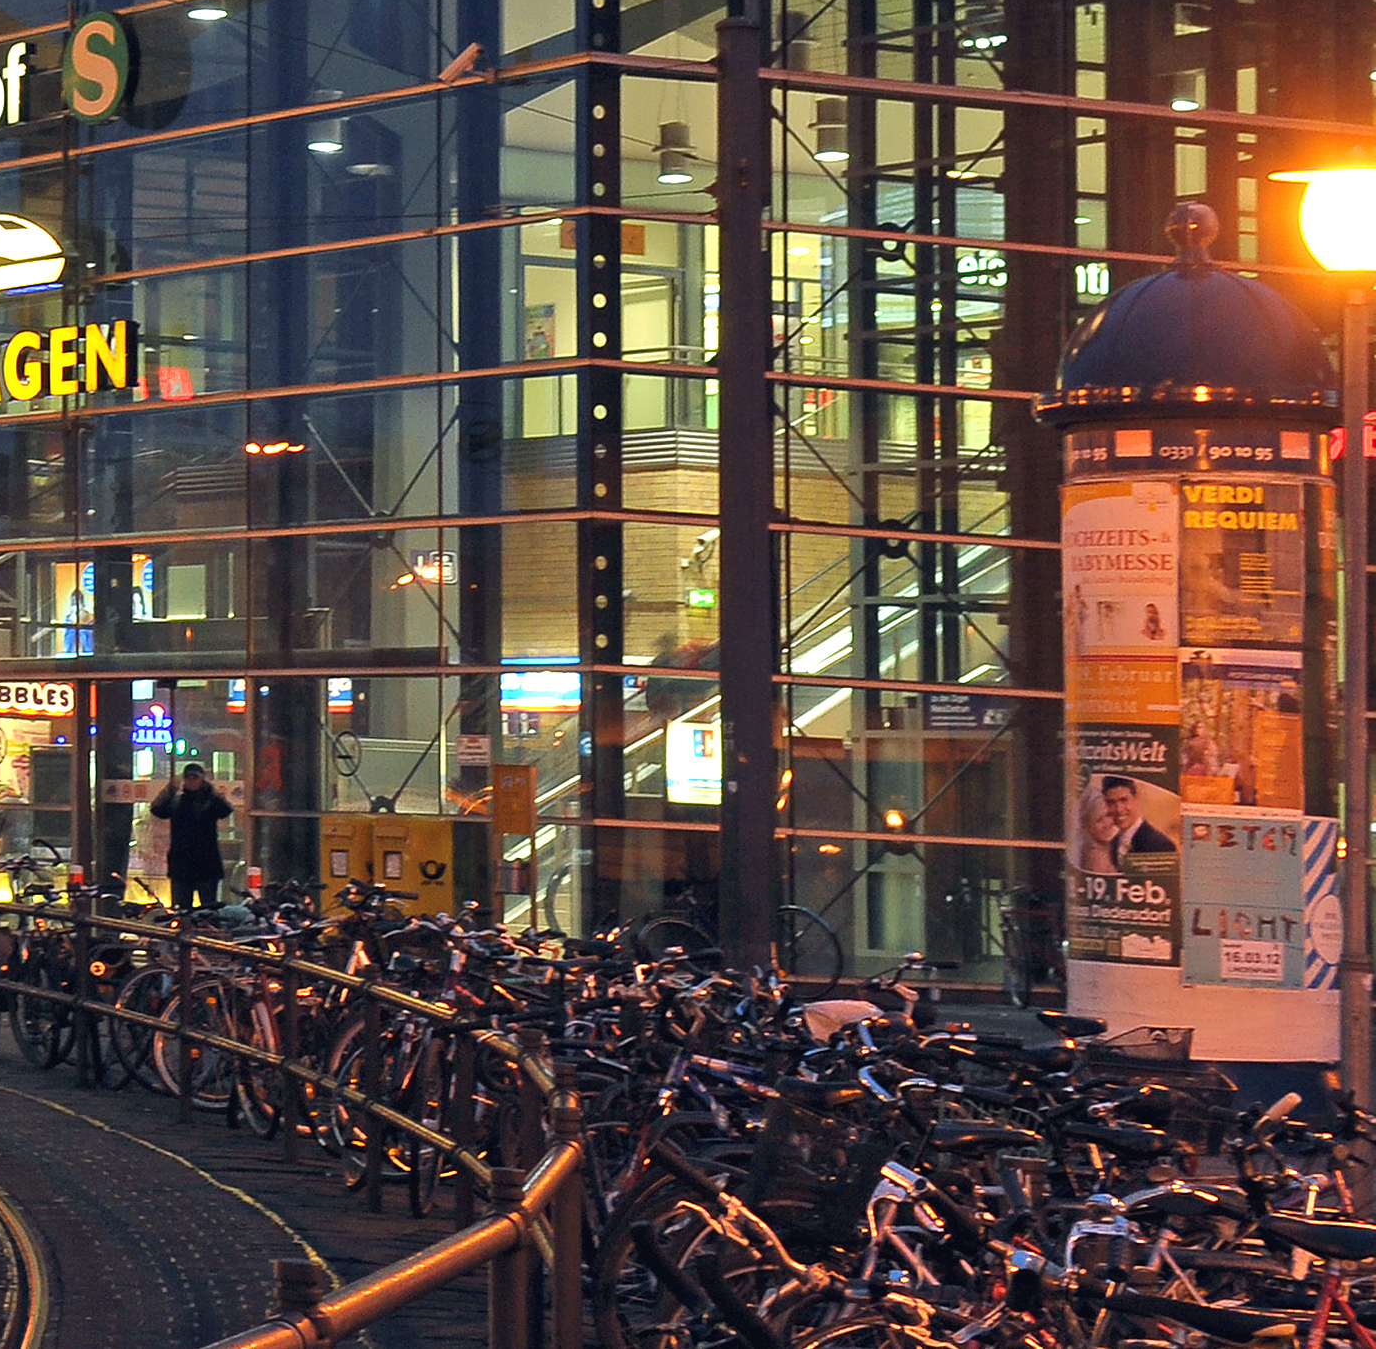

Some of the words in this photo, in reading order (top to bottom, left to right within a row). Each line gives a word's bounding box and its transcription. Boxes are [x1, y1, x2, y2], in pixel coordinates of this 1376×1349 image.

[71, 19, 116, 116] S
[1209, 446, 1233, 460] 90
[1183, 485, 1265, 504] VERDI
[1184, 510, 1299, 530] REQUIEM
[1192, 823, 1297, 857] PETER
[1116, 879, 1171, 904] Feb.
[1192, 907, 1299, 941] LICHT
